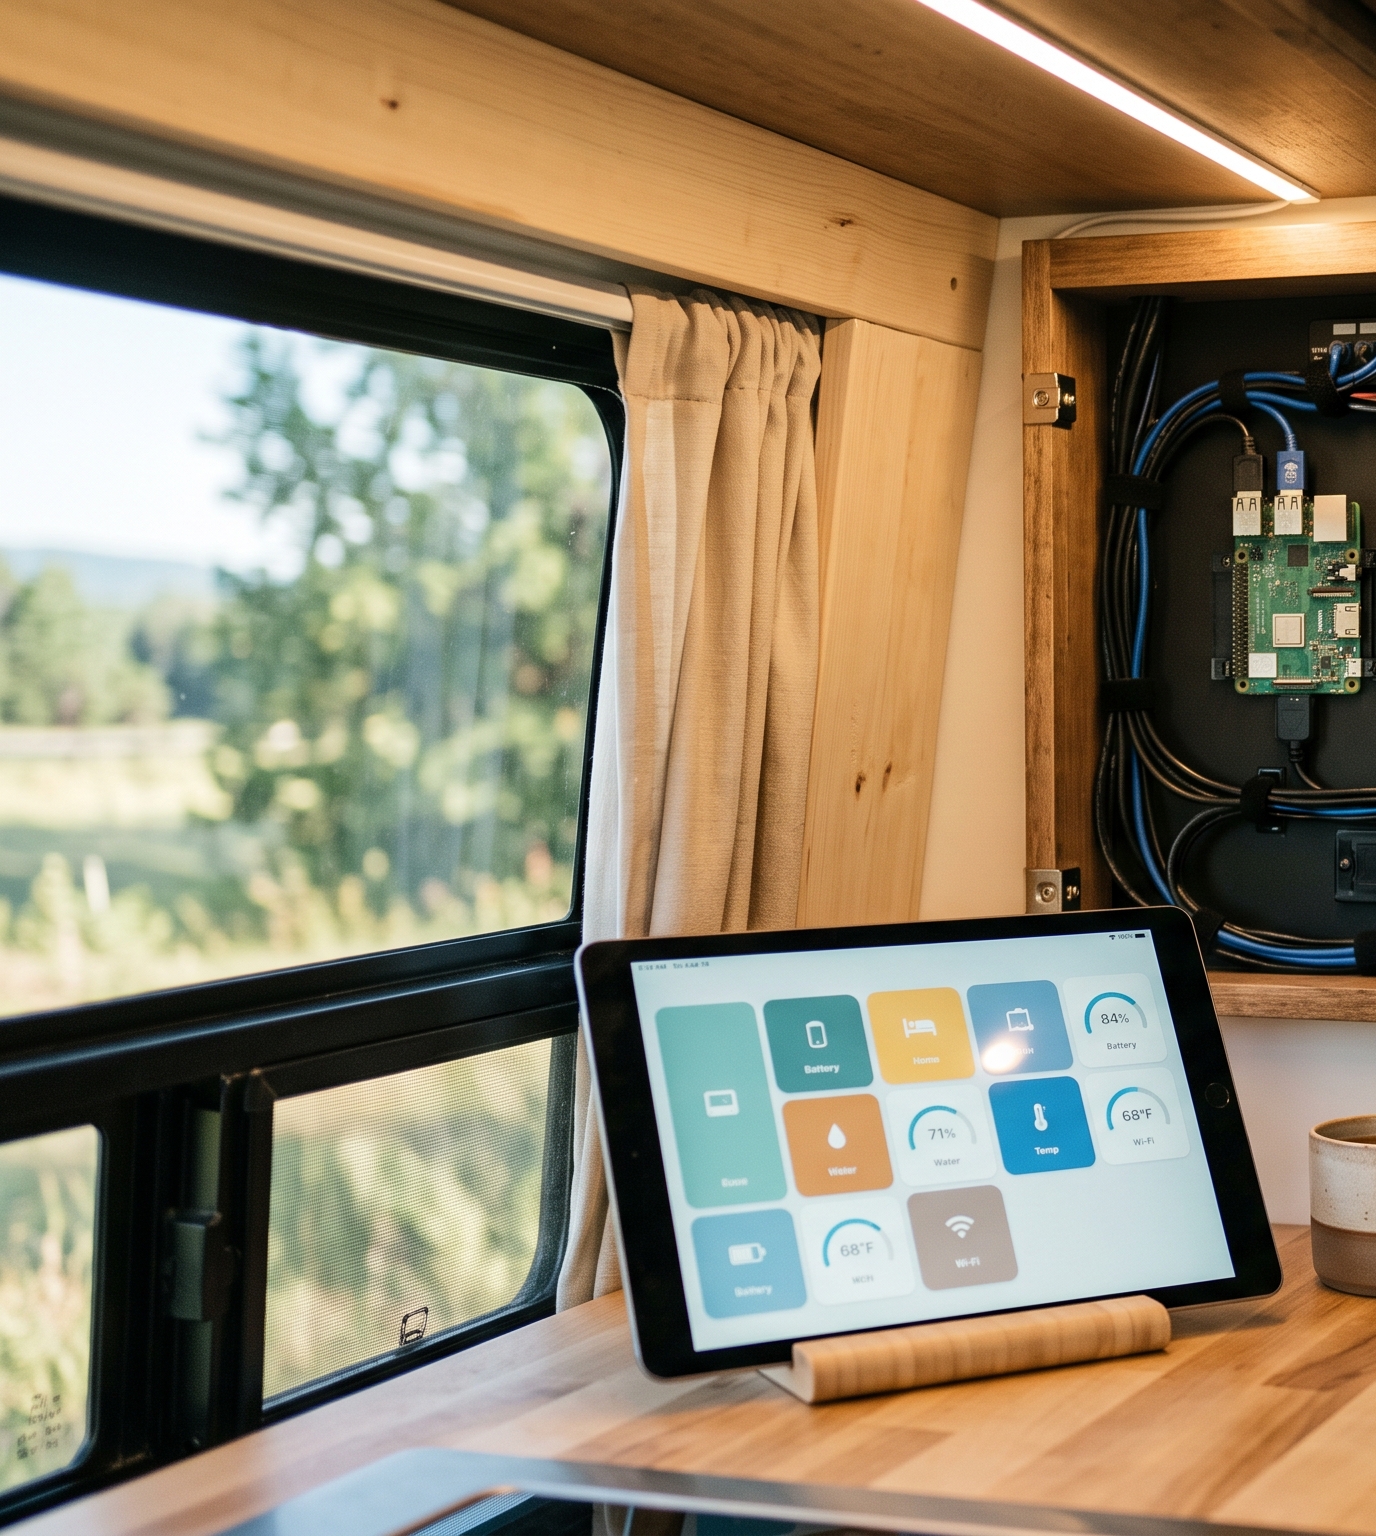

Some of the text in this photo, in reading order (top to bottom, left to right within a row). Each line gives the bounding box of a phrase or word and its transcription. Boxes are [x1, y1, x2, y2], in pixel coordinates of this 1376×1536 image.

[1100, 1012, 1130, 1025] 84%
[1106, 1041, 1137, 1051] Battery
[803, 1064, 840, 1074] Battery
[927, 1127, 957, 1141] 71%
[1034, 1146, 1060, 1156] Temp
[933, 1157, 961, 1167] Water
[840, 1241, 874, 1257] 68°F
